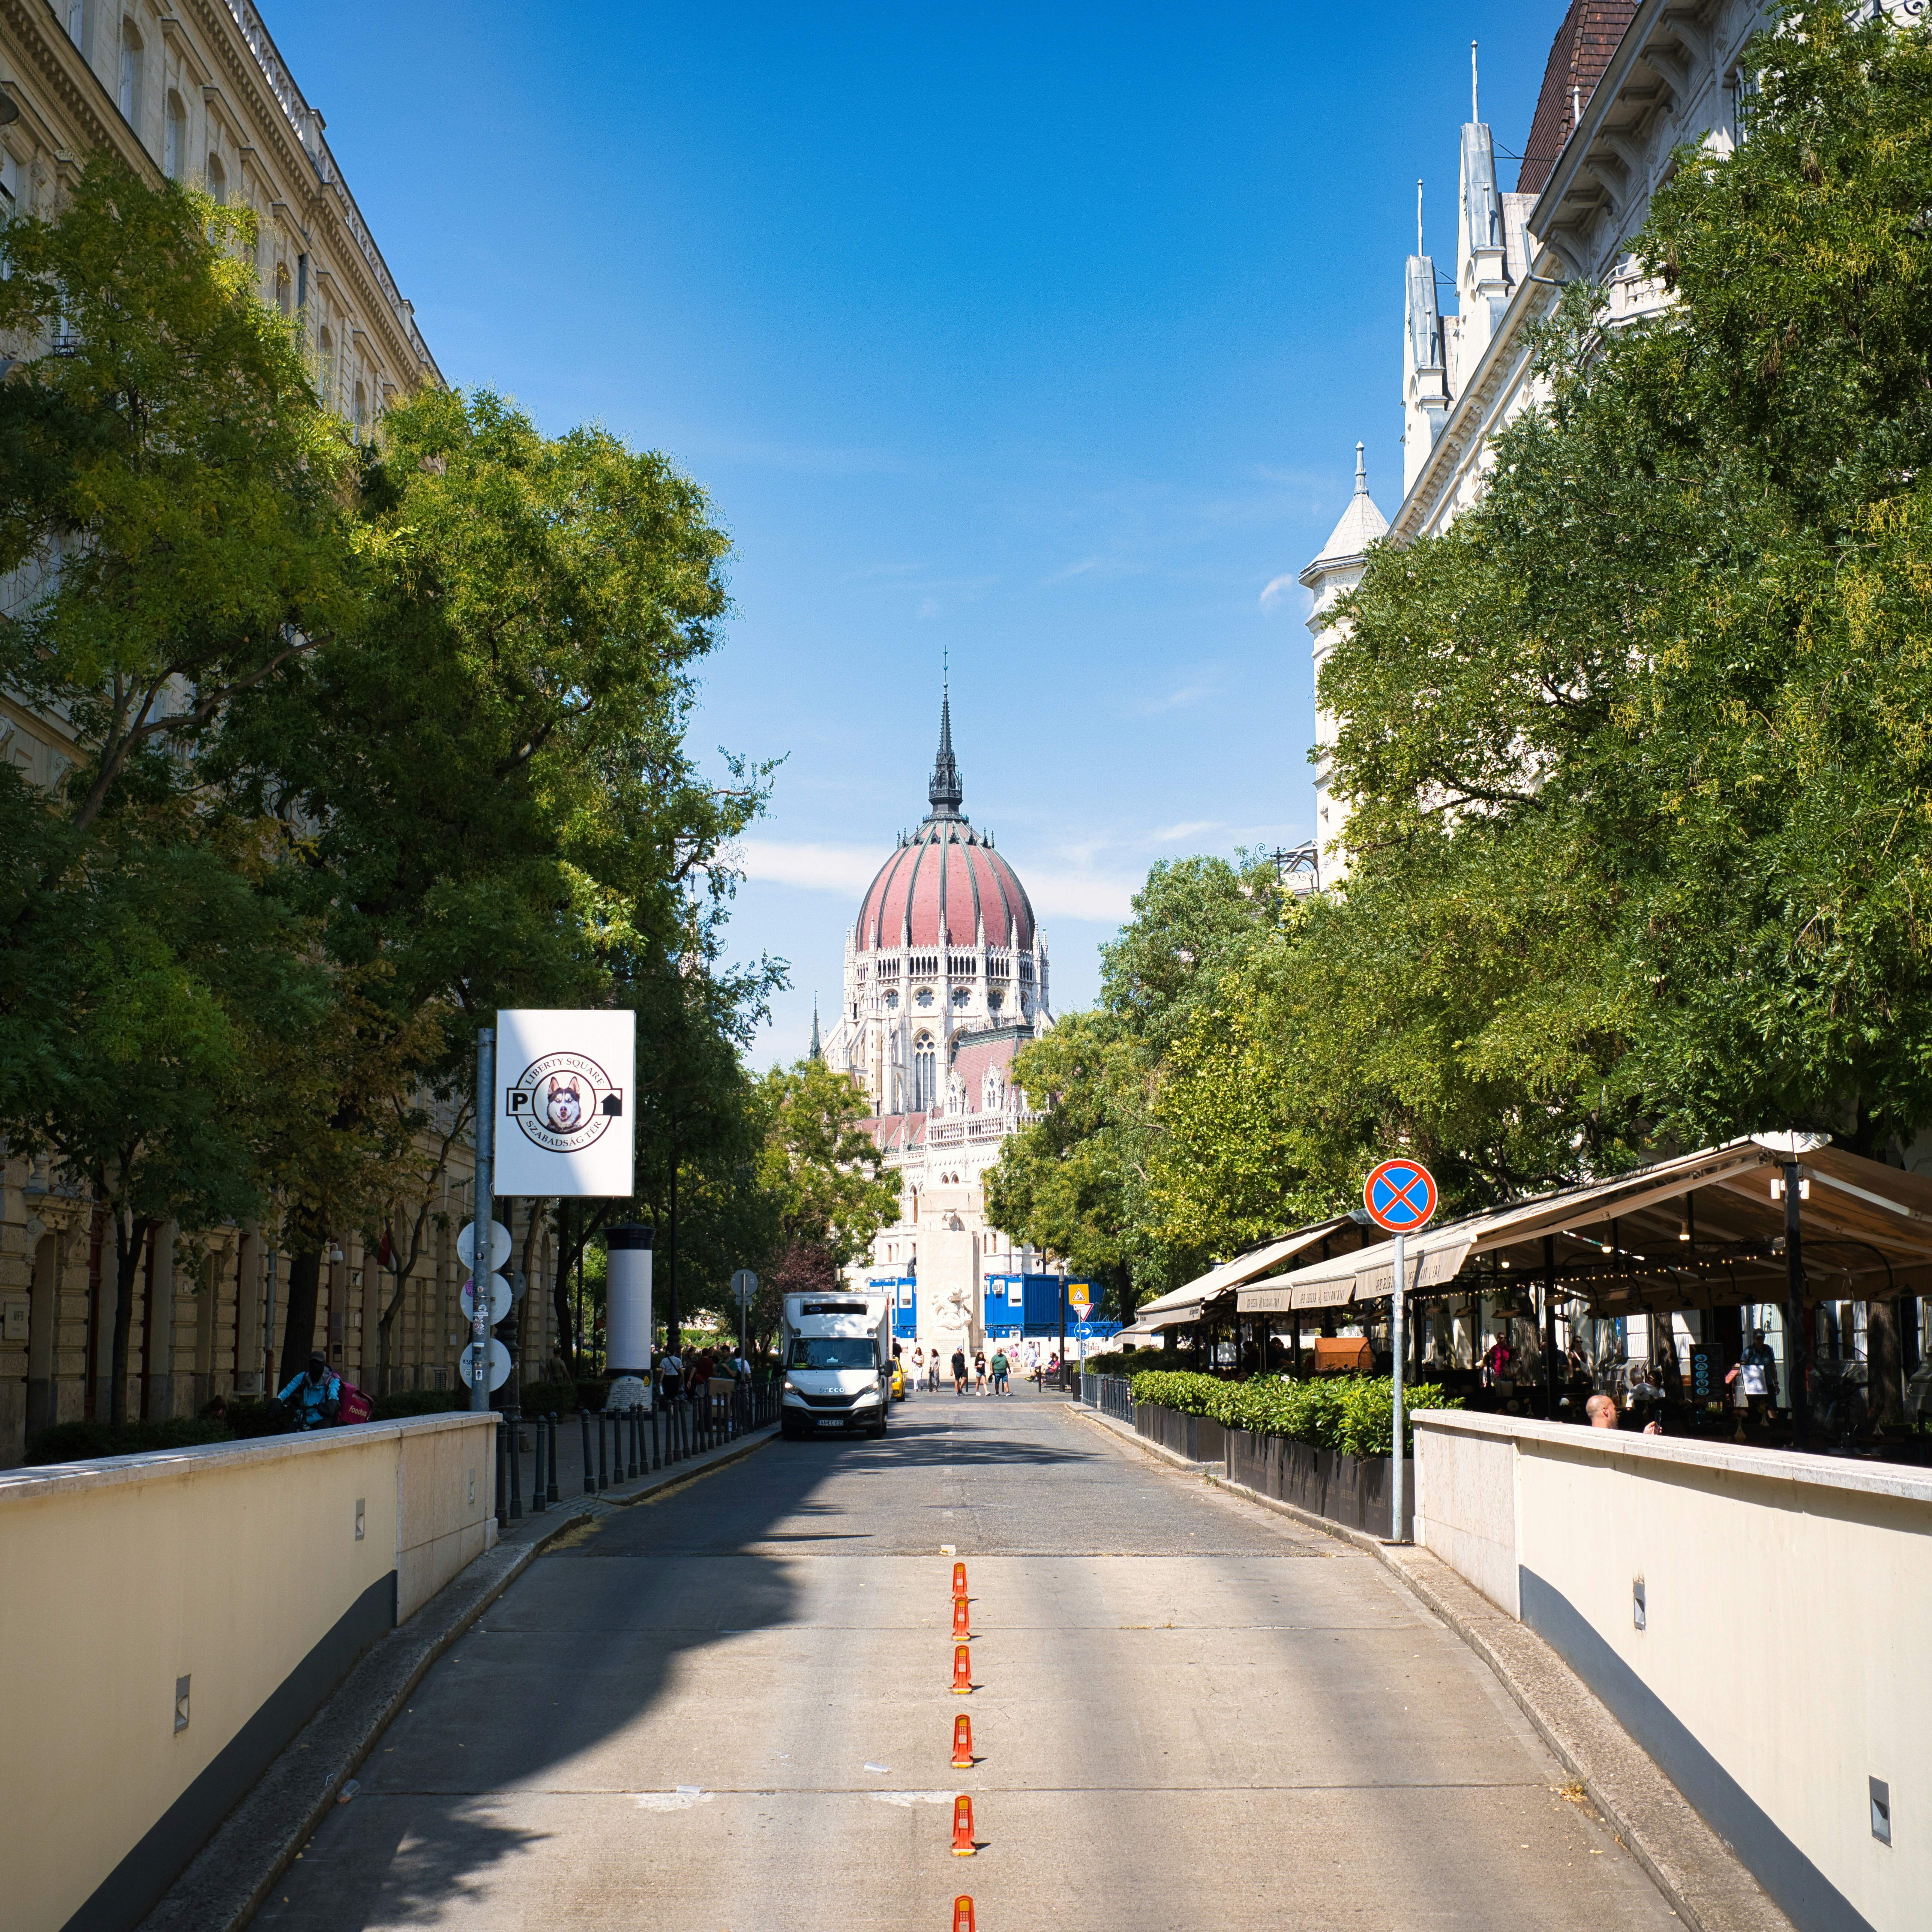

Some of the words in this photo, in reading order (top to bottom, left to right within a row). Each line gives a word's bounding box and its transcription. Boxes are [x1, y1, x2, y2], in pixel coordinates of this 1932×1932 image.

[525, 1058, 564, 1085] LIBERTY
[566, 1058, 604, 1086] SQUARE
[512, 1093, 528, 1111] P
[526, 1120, 584, 1147] SZABADSÁG
[584, 1121, 602, 1138] TÉR
[14, 1311, 24, 1321] MFB
[349, 1405, 367, 1417] foodora
